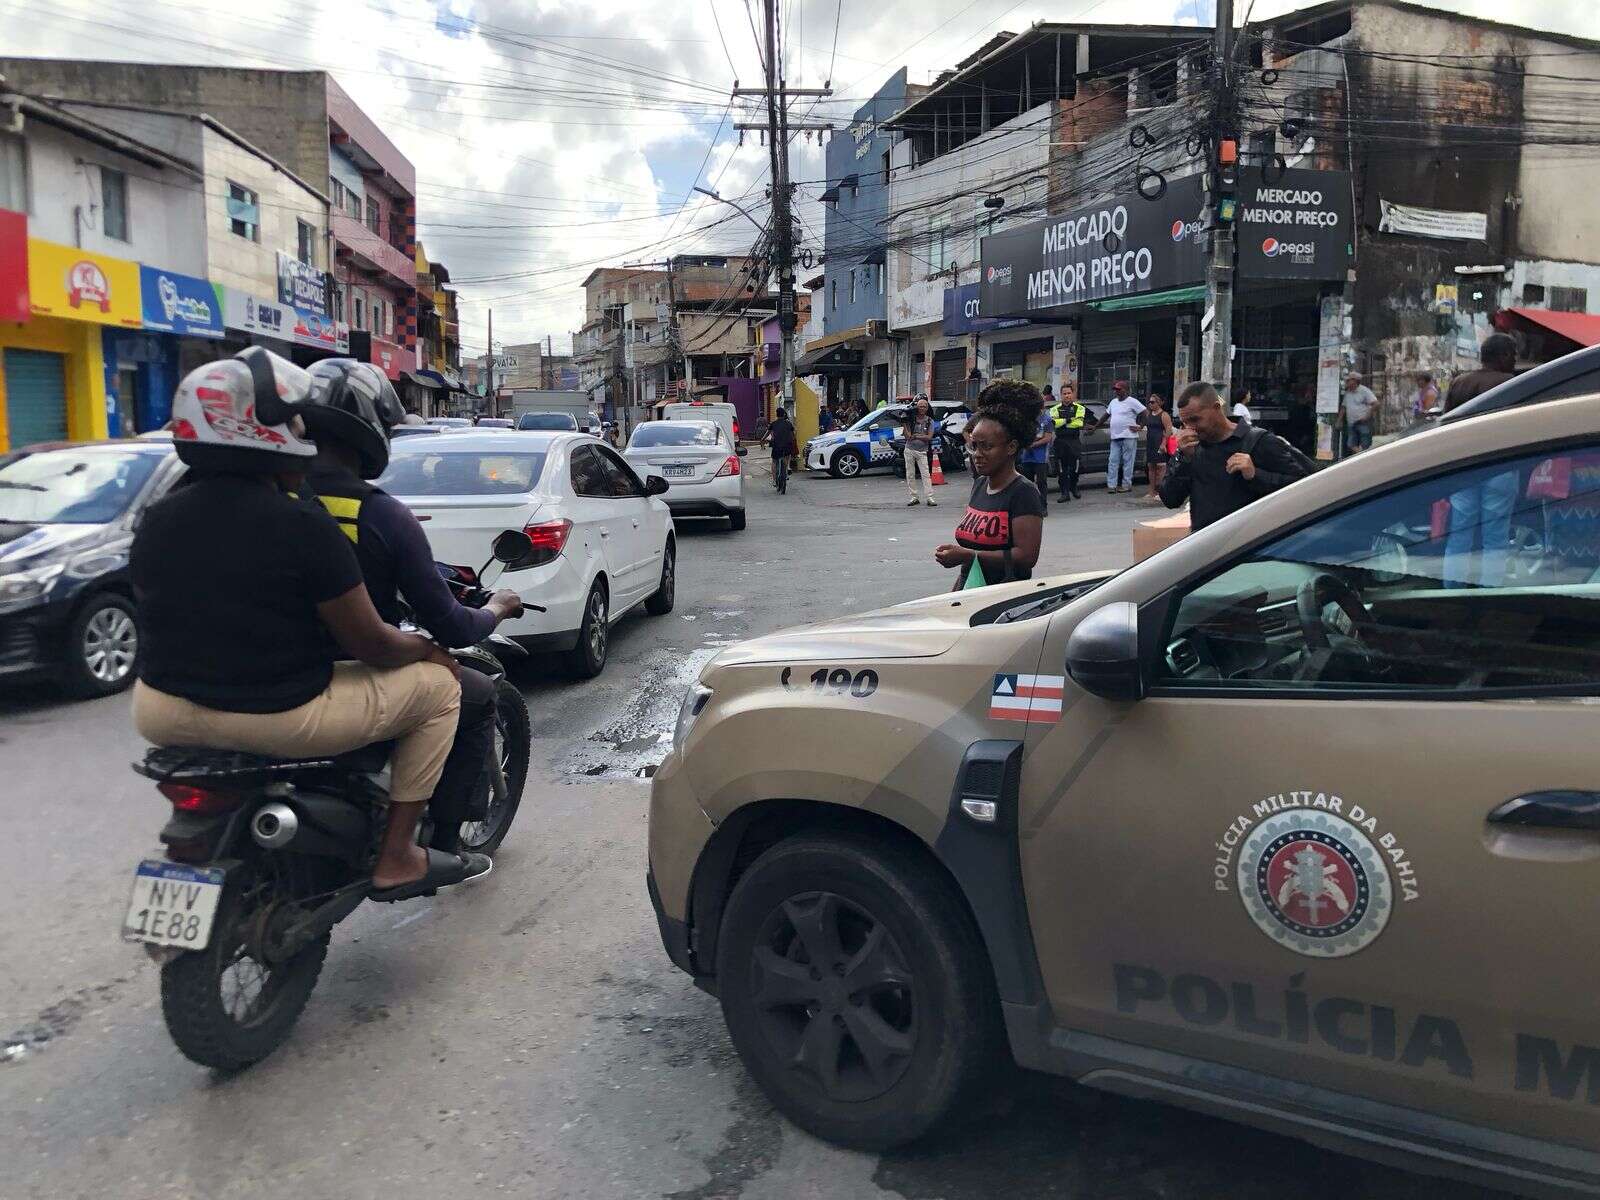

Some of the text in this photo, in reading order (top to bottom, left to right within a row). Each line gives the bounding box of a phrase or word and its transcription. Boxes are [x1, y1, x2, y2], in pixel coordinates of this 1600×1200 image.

[1256, 188, 1322, 205] MERCADO
[1042, 205, 1128, 255] MERCADO
[1242, 208, 1338, 228] MENOR PREÇO
[1279, 241, 1315, 256] pepsi
[1027, 247, 1153, 300] MENOR PREÇO
[811, 668, 879, 698] 190
[1214, 791, 1420, 902] POLÍCIA MILITAR DA BAHIA
[148, 880, 202, 910] NYV
[134, 908, 200, 941] 1E88
[1113, 962, 1474, 1083] POLÍCIA
